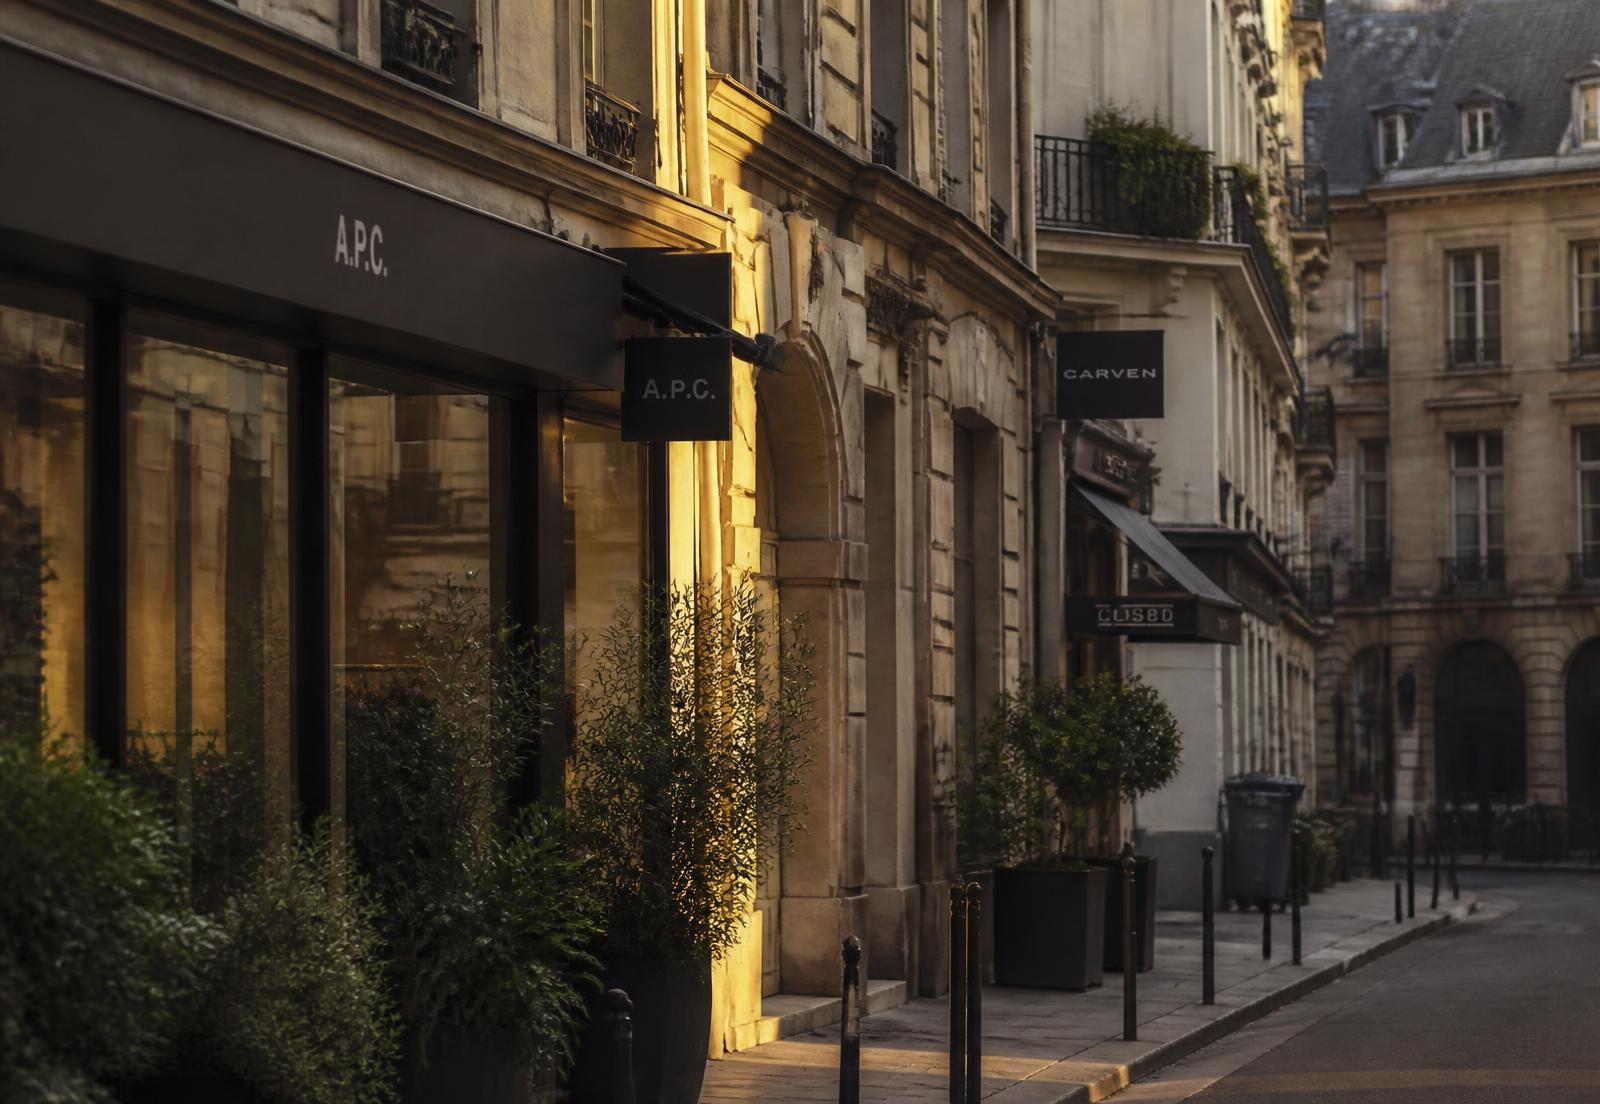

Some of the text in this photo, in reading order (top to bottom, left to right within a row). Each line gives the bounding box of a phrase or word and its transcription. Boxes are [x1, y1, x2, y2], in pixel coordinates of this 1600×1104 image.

[335, 214, 388, 277] A.P.C.
[1063, 368, 1157, 380] CARVEN
[641, 378, 716, 400] A.P.C.
